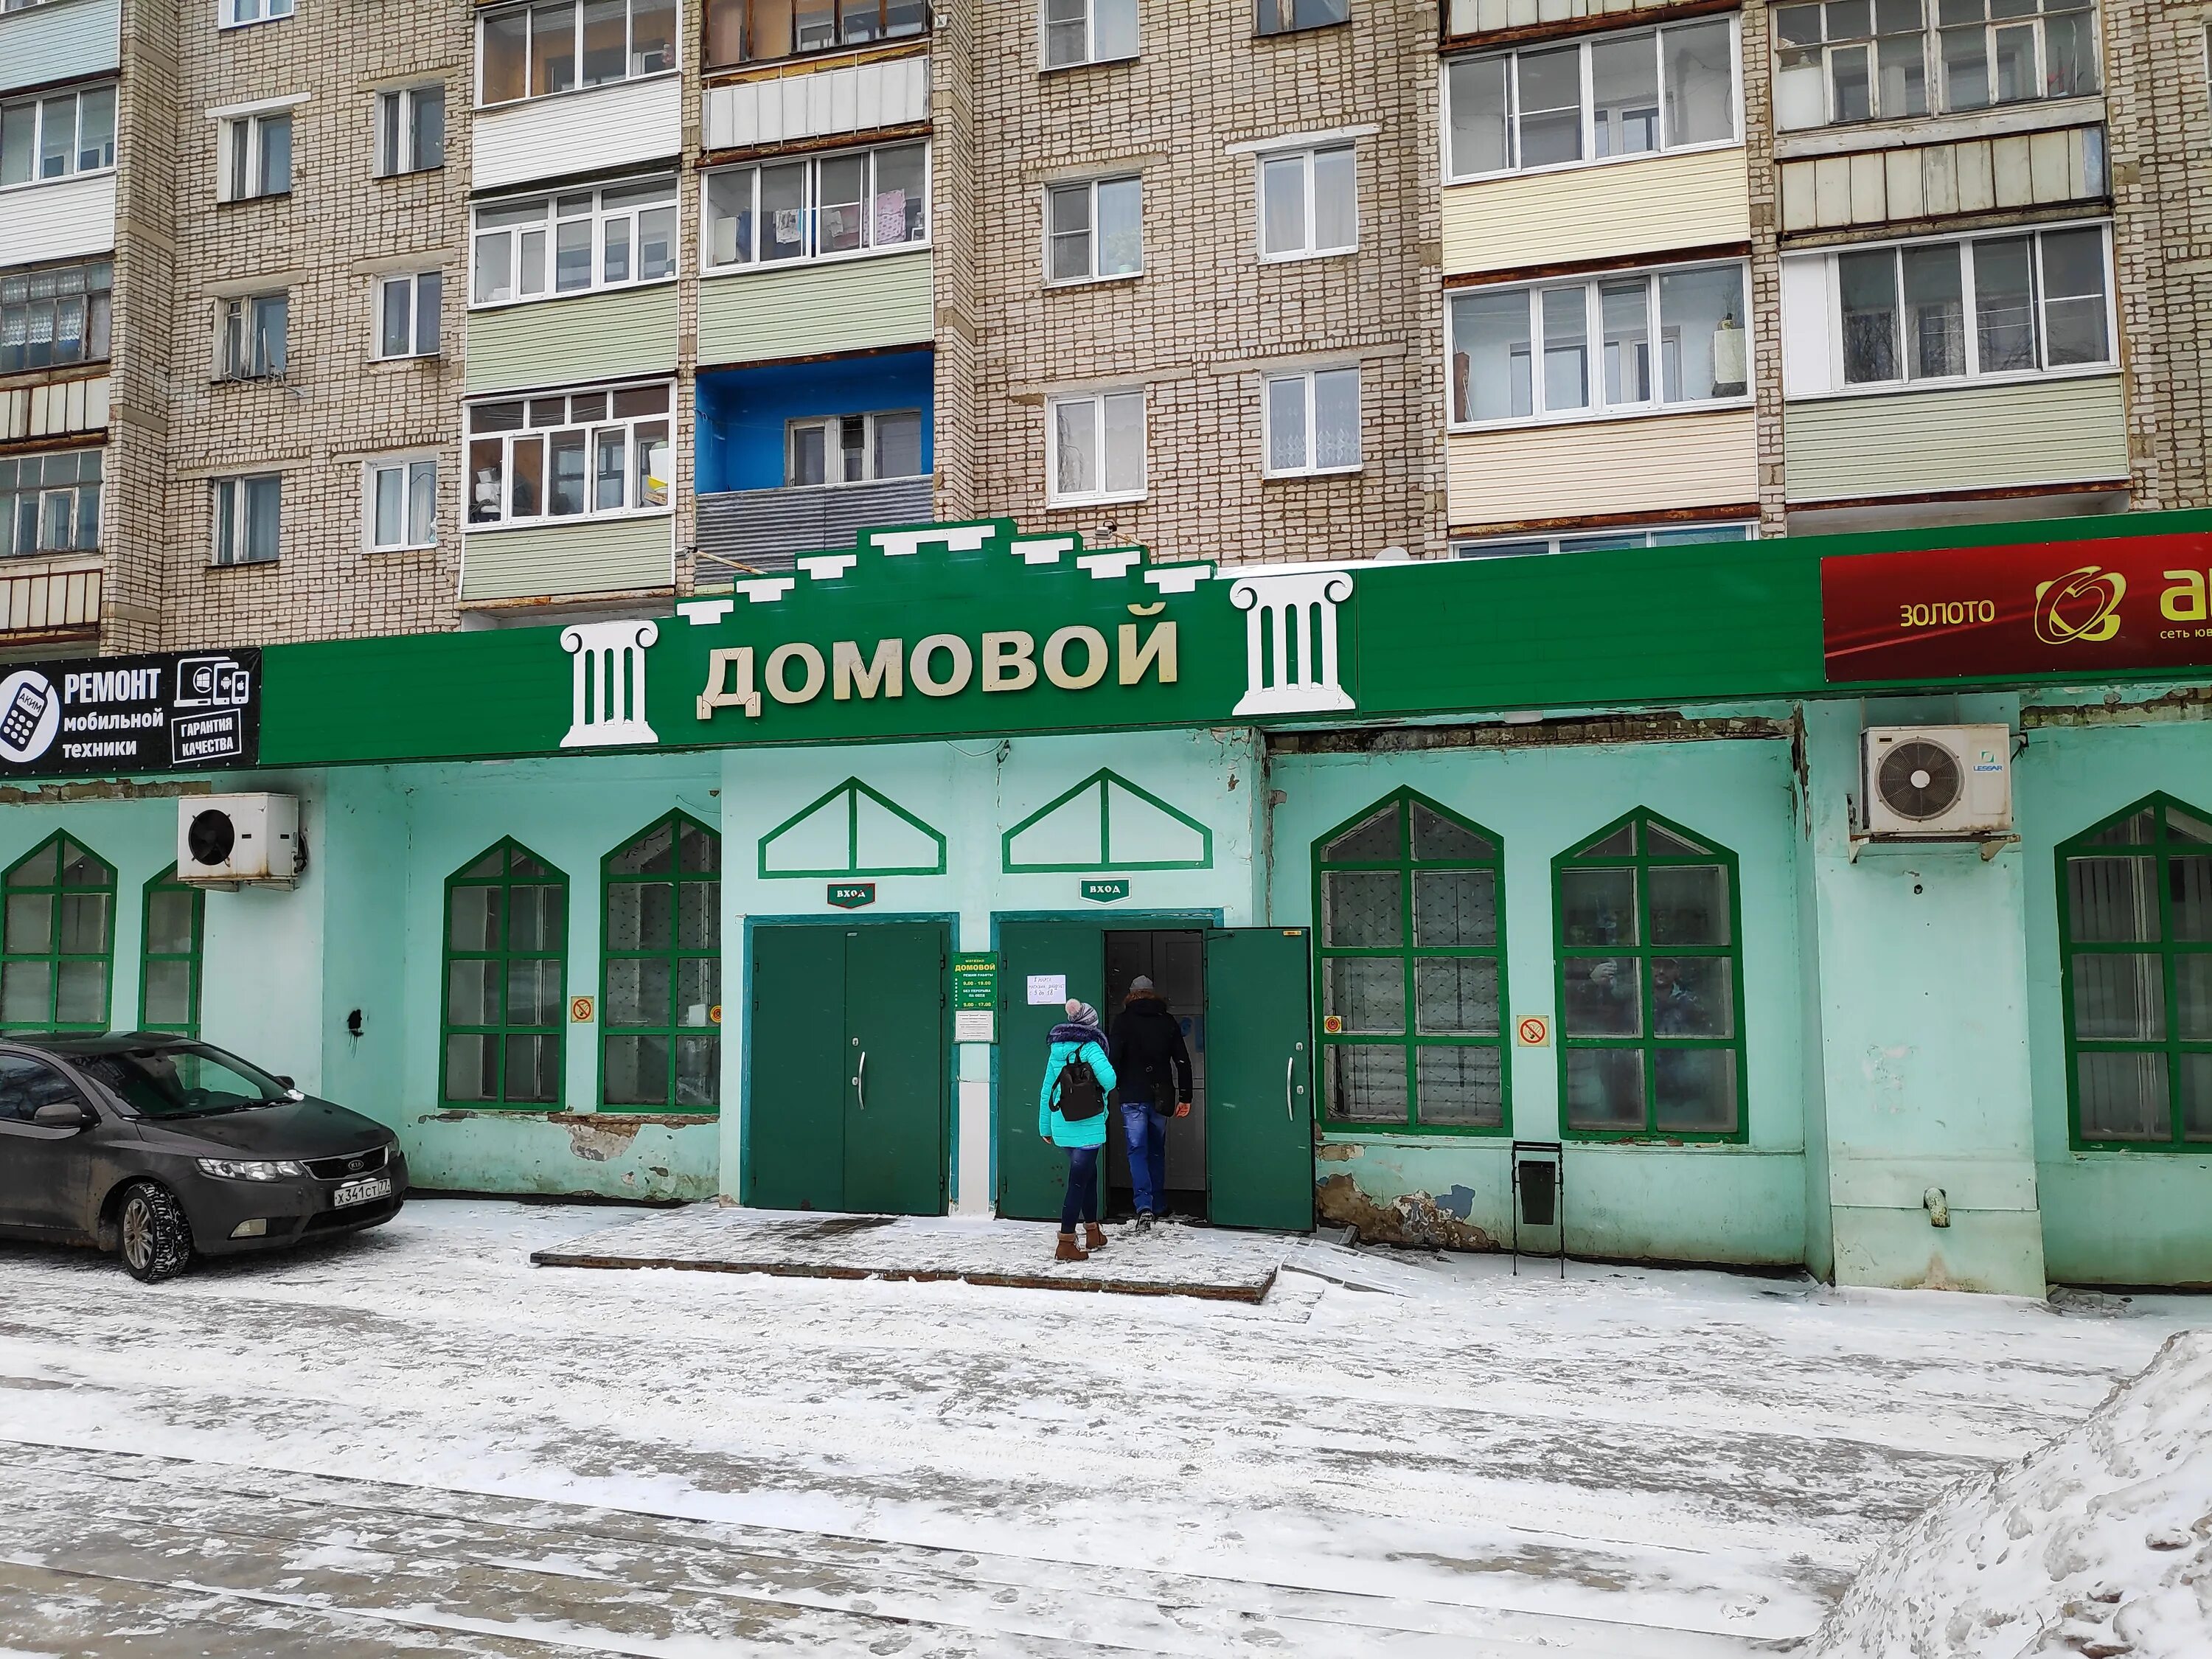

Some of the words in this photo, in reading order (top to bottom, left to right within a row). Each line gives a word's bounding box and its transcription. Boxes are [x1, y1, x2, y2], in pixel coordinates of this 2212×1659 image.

[1900, 599, 1994, 627] ЗОЛОТО
[2160, 630, 2190, 639] сеть
[697, 602, 1178, 720] ДОМОВОЙ
[64, 667, 161, 704] РЕМОНТ
[19, 693, 42, 713] АКИМ
[63, 708, 164, 731] мобильной
[181, 717, 233, 737] ГАРАНТИЯ
[63, 740, 136, 758] техники
[182, 737, 234, 757] КАЧЕСТВА
[836, 889, 866, 898] ВХОД
[1090, 885, 1121, 894] ВХОД
[955, 963, 995, 972] ДОМОВОЙ
[379, 1180, 387, 1190] 77
